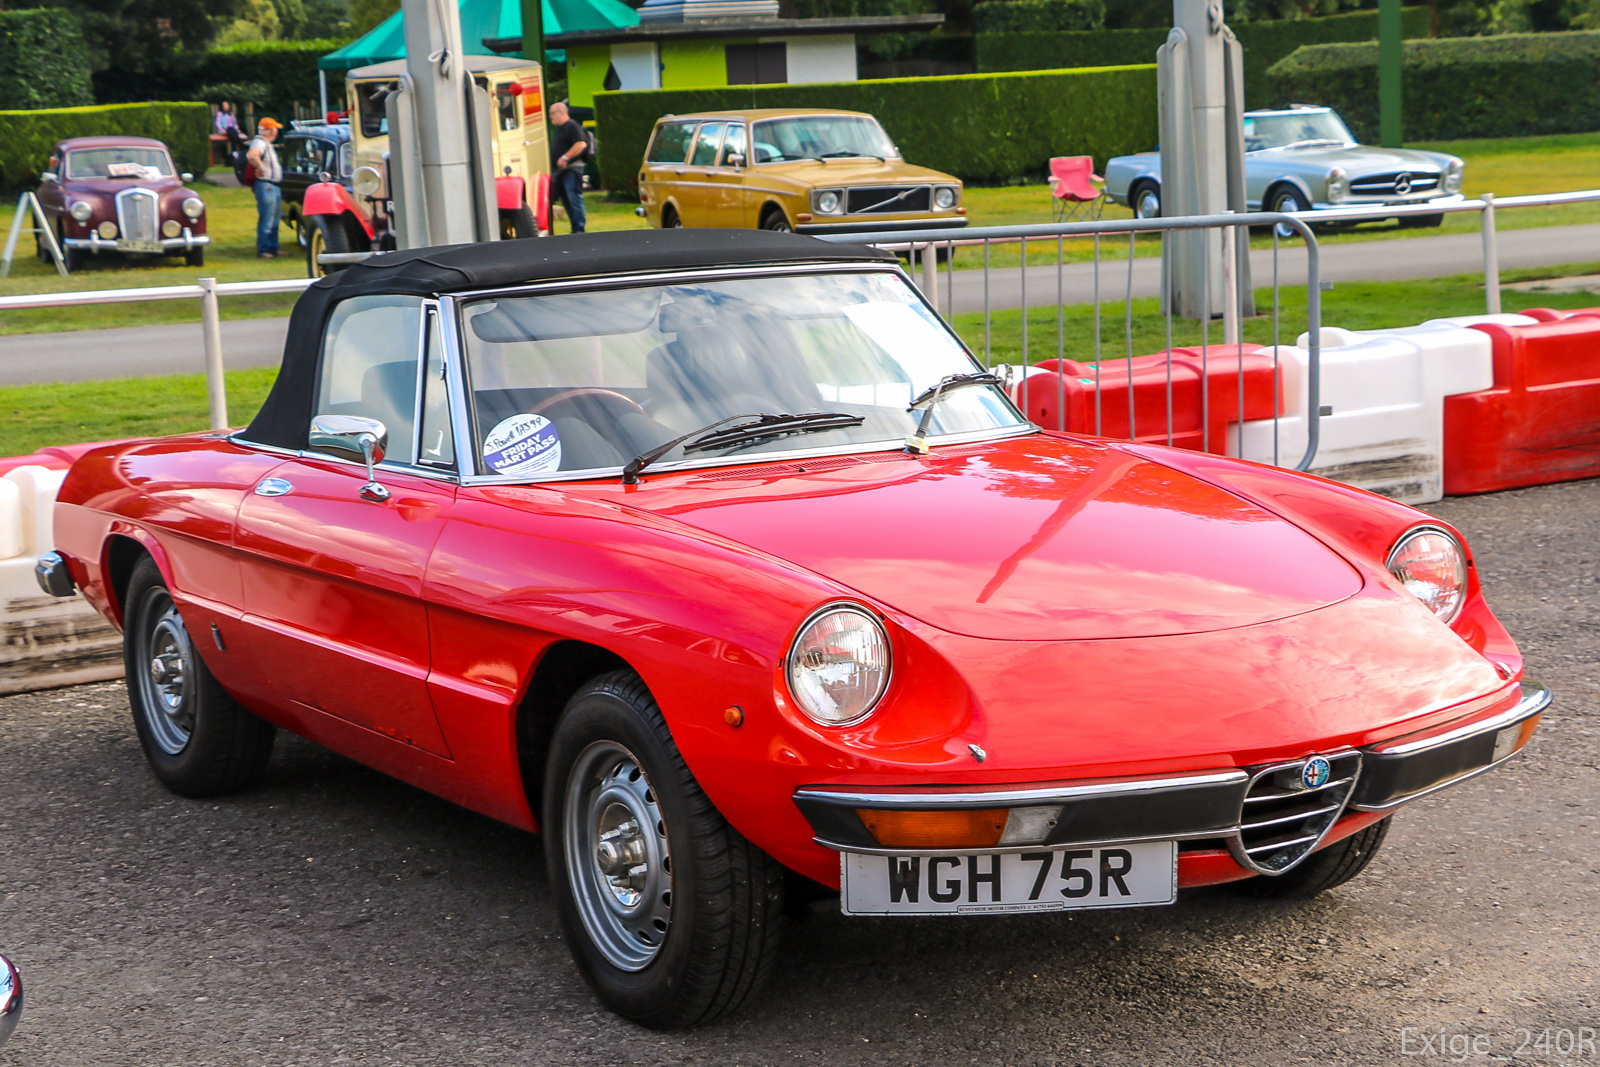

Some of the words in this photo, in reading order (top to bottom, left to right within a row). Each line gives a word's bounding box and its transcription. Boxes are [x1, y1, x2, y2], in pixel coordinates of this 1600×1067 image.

[493, 450, 527, 468] MART
[527, 434, 556, 456] PASS
[500, 433, 542, 459] FRIDAY
[888, 855, 1002, 903] WGH
[1020, 849, 1133, 901] 75R
